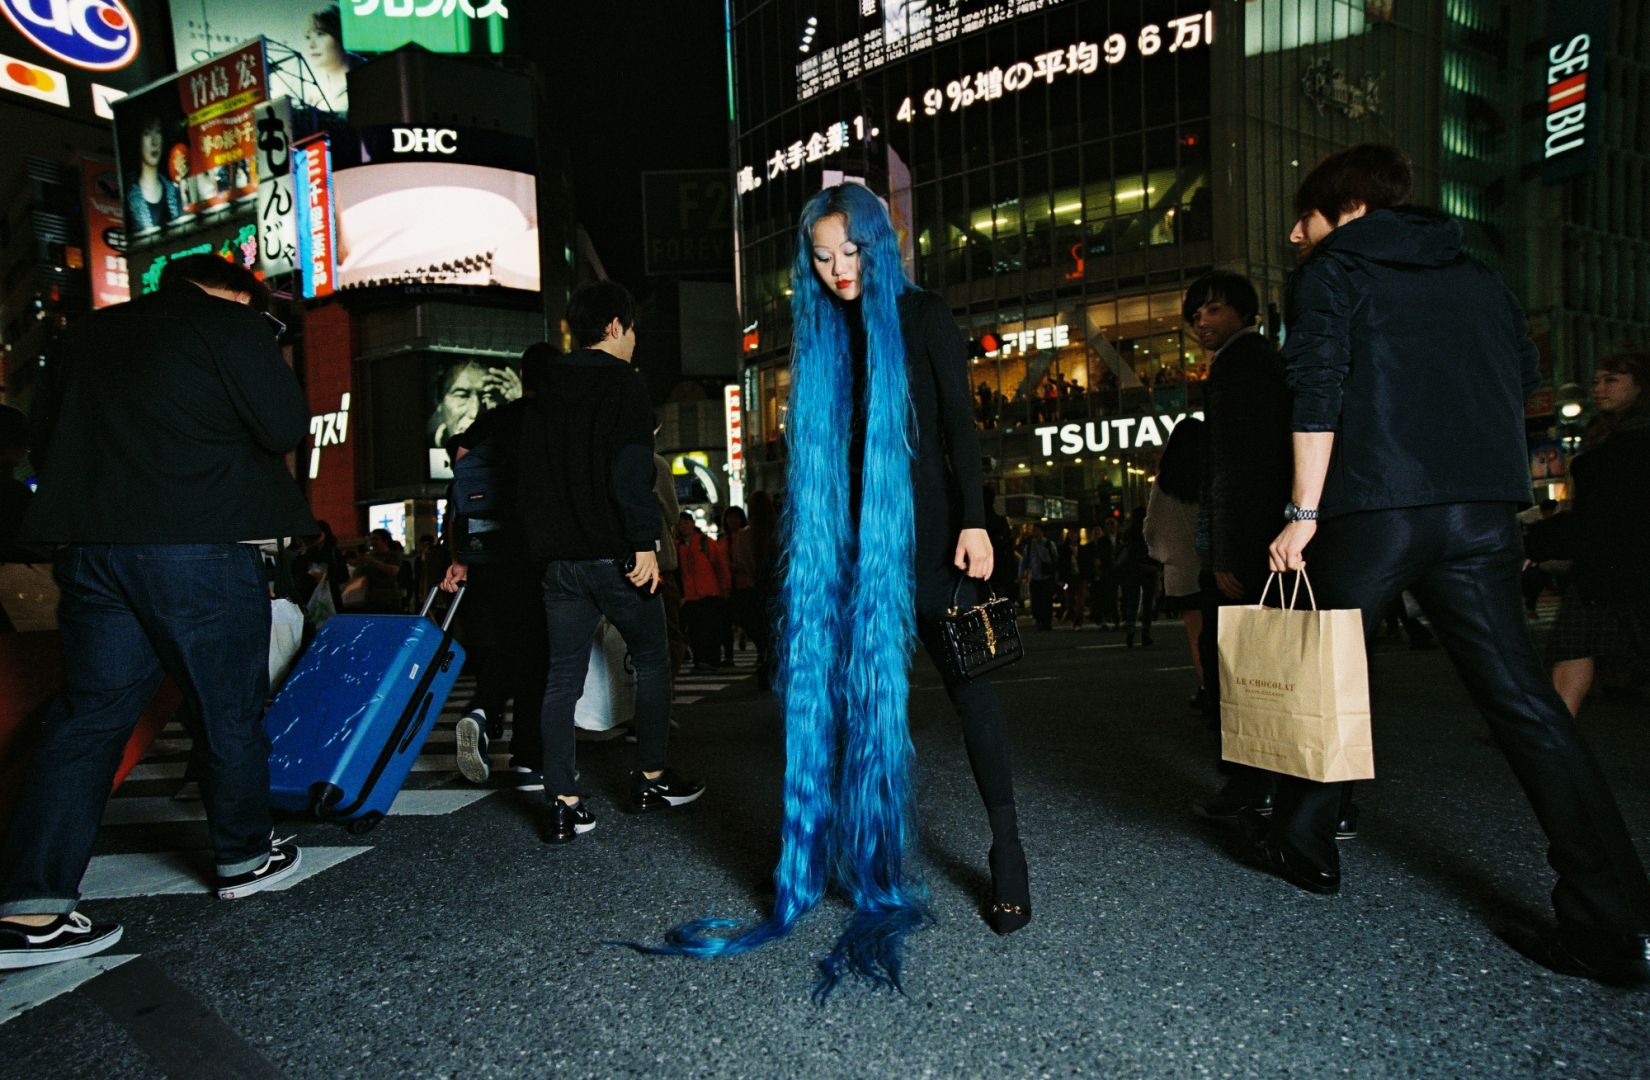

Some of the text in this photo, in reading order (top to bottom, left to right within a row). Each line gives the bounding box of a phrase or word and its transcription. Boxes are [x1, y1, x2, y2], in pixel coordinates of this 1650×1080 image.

[1544, 33, 1591, 159] SEIBU
[393, 128, 458, 153] DHC
[257, 105, 296, 268] もんじゃ
[308, 392, 351, 480] クスリ
[1034, 411, 1206, 457] TSUTAY
